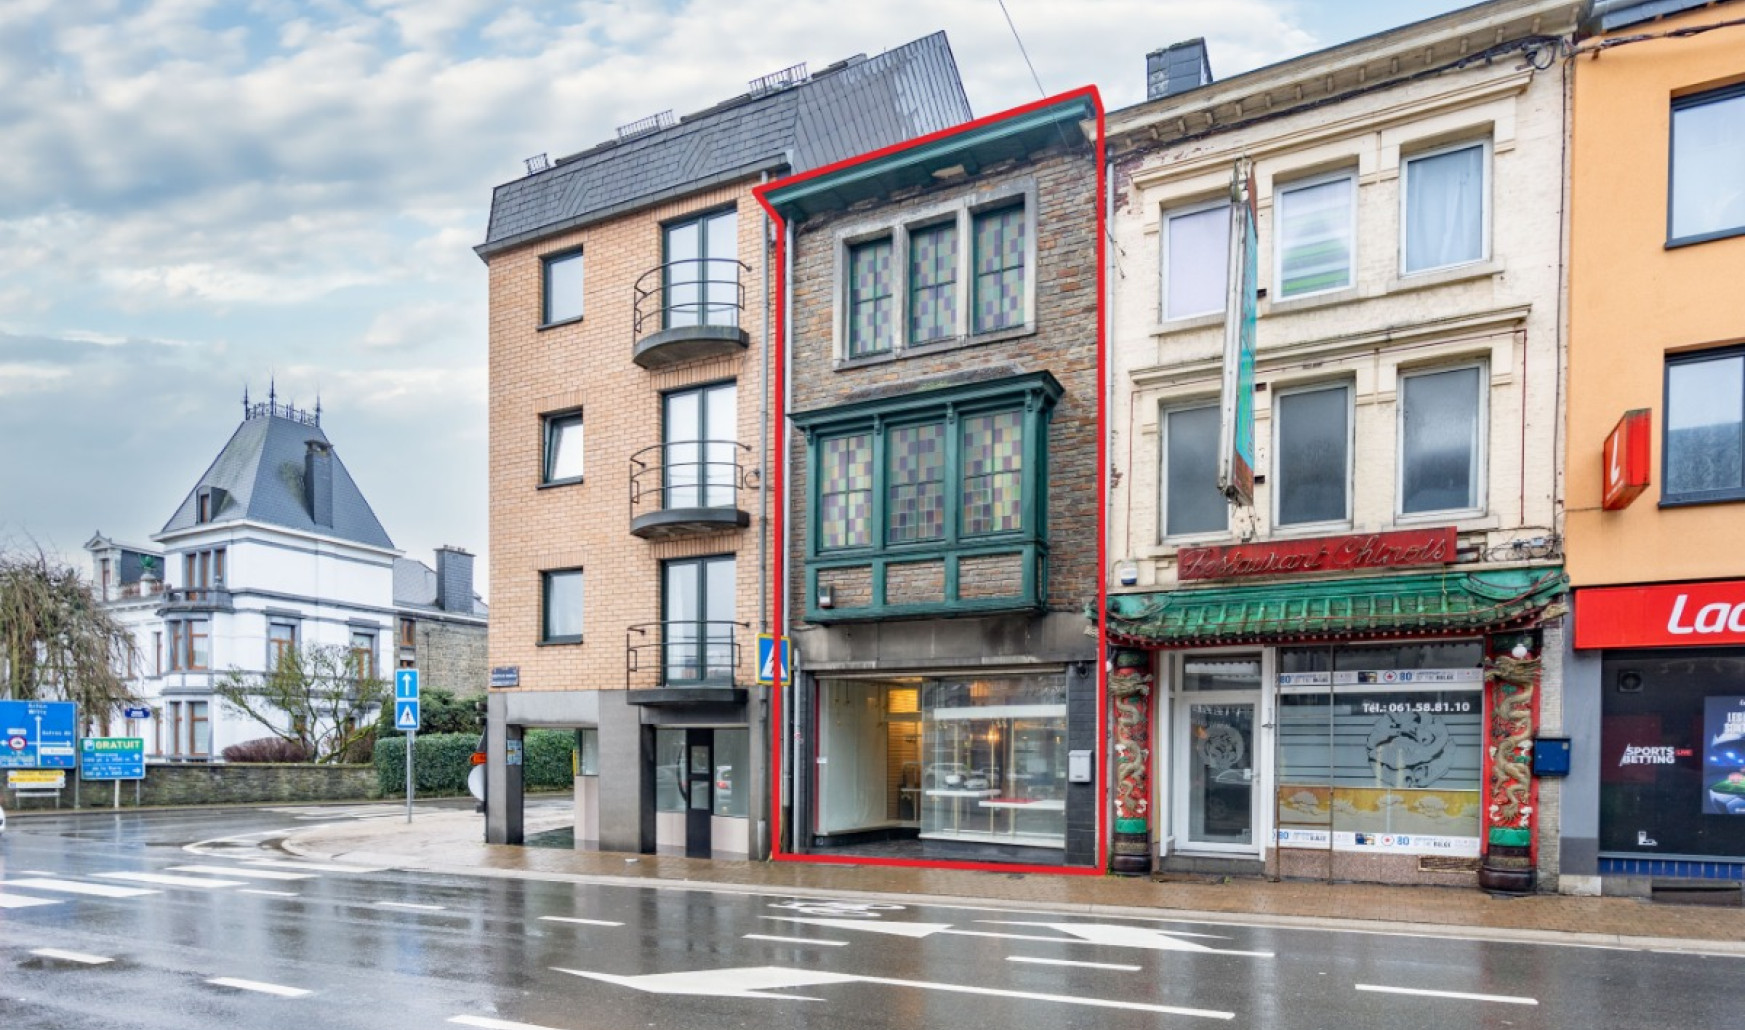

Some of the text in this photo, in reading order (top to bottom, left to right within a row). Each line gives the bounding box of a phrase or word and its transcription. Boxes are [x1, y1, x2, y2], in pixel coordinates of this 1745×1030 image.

[1181, 534, 1449, 577] Restaurant Chinois
[1400, 671, 1412, 682] 80
[1388, 701, 1471, 713] 061.58.81.10
[95, 740, 141, 750] GRATUIT
[1626, 746, 1675, 756] SPORTS
[1622, 755, 1676, 764] BETTING
